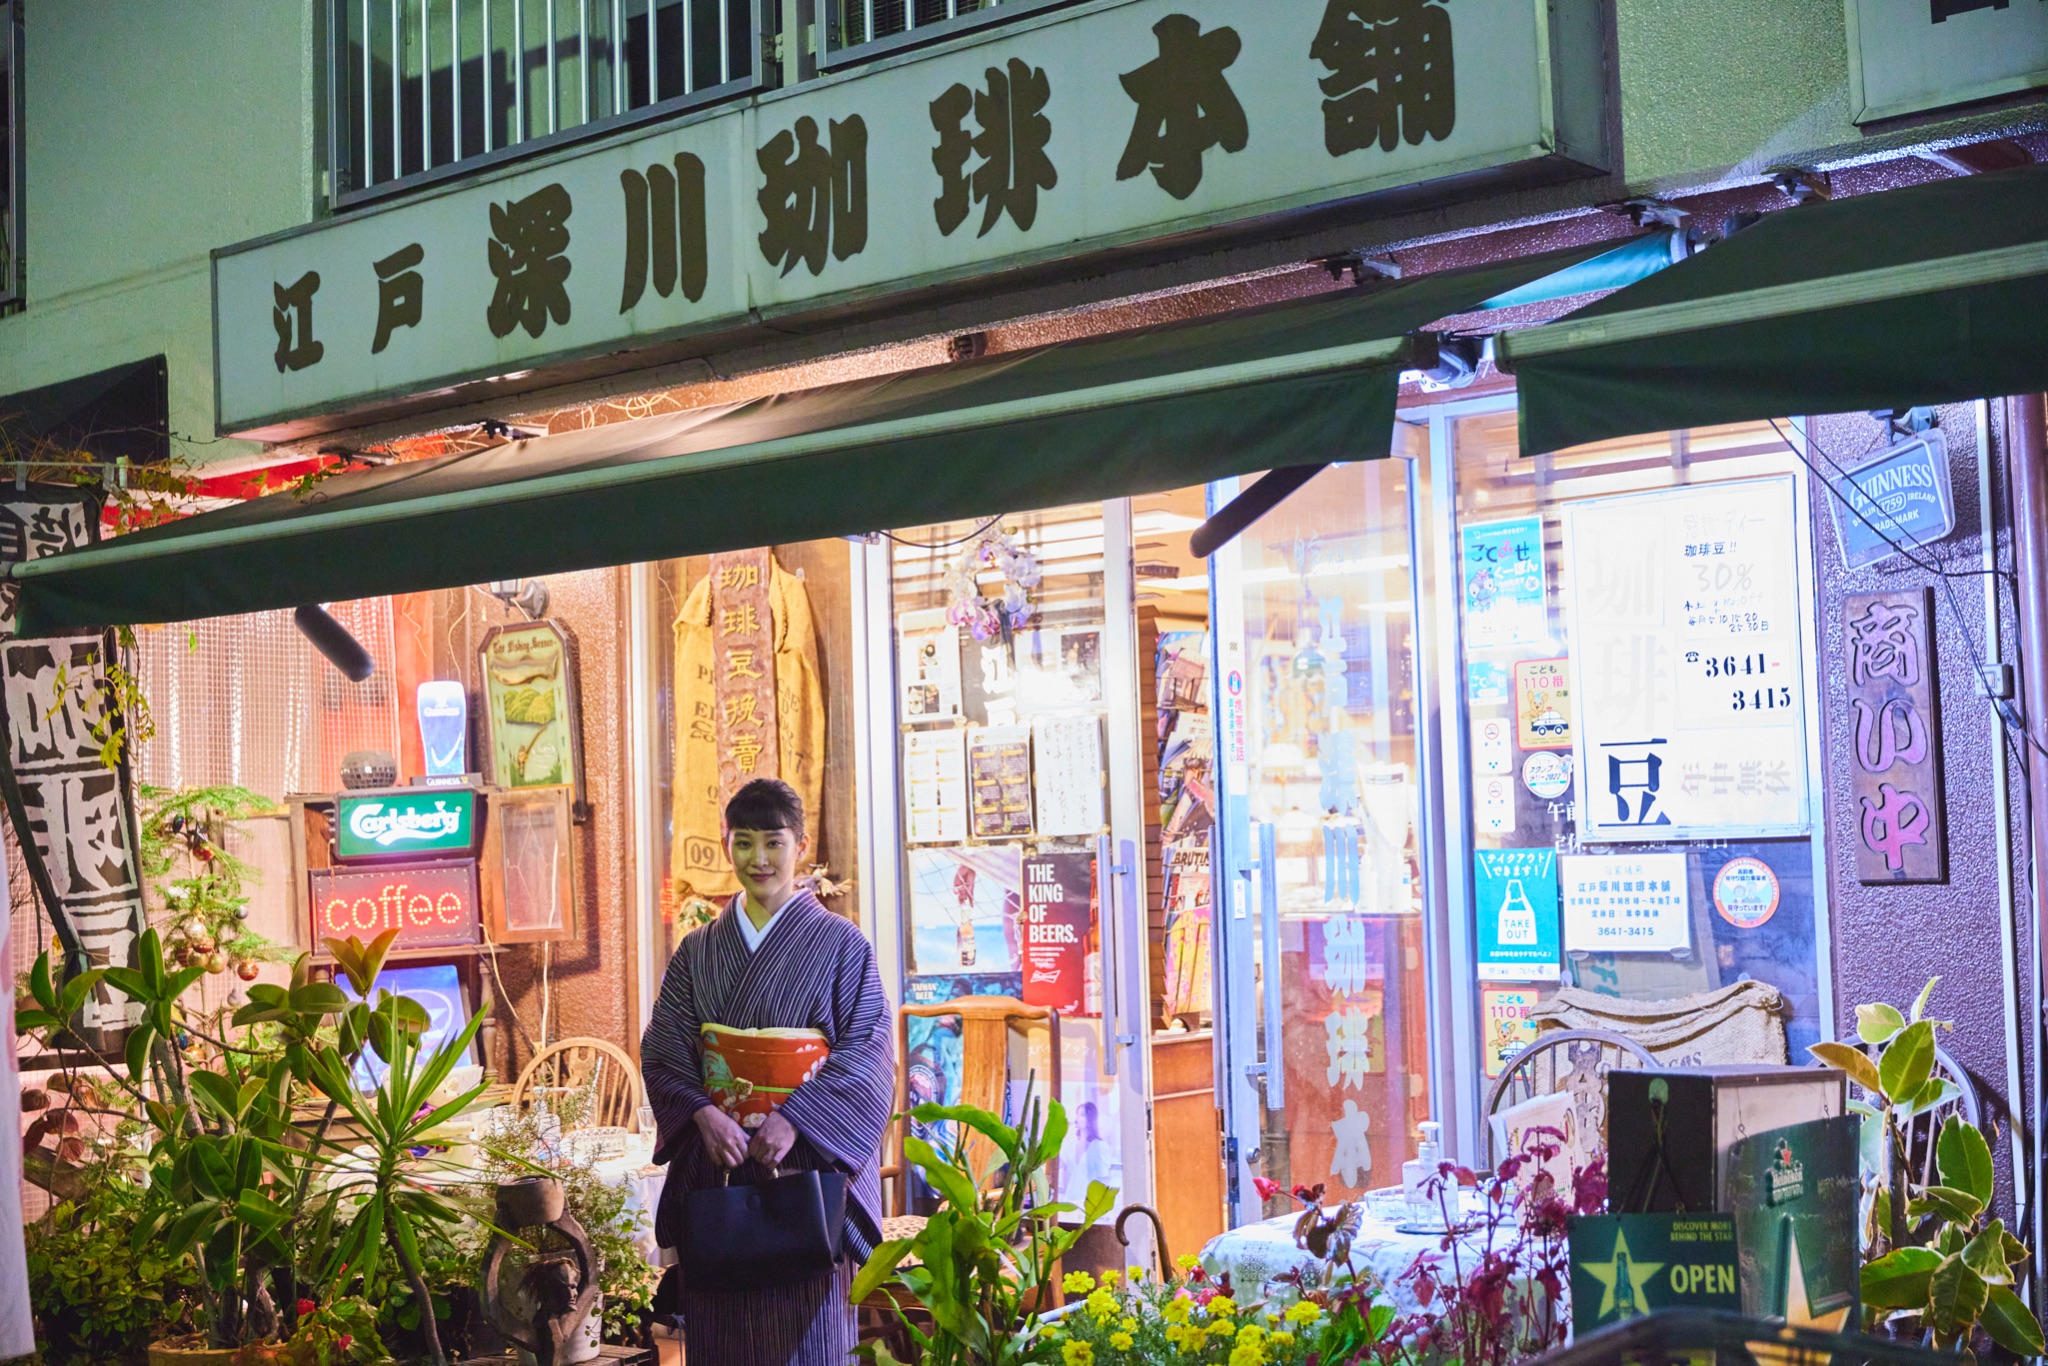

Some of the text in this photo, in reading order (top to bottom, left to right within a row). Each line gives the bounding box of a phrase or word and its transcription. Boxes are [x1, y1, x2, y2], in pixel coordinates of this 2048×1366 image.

[1850, 463, 1933, 511] GUINNESS
[1880, 496, 1903, 514] 1759
[1907, 492, 1936, 504] IRELAND
[1691, 562, 1756, 593] 30%
[1731, 686, 1792, 712] 3415
[1849, 601, 1930, 872] 商い中
[1679, 758, 1791, 797] 年中無休
[350, 800, 461, 846] Carlsberg
[1487, 853, 1545, 864] テイクアウト
[1028, 864, 1055, 882] THE
[1029, 884, 1063, 902] KING
[325, 884, 462, 932] coffee
[1029, 904, 1047, 923] OF
[1504, 919, 1530, 928] TAKE
[1597, 926, 1655, 937] 3641-3415
[1029, 924, 1078, 943] BEERS.
[1506, 930, 1529, 939] OUT
[1497, 994, 1525, 1005] こども
[1673, 1222, 1708, 1231] DISCOVER
[1670, 1232, 1697, 1241] BEHIND
[1699, 1232, 1712, 1241] THE
[1670, 1264, 1735, 1294] OPEN
